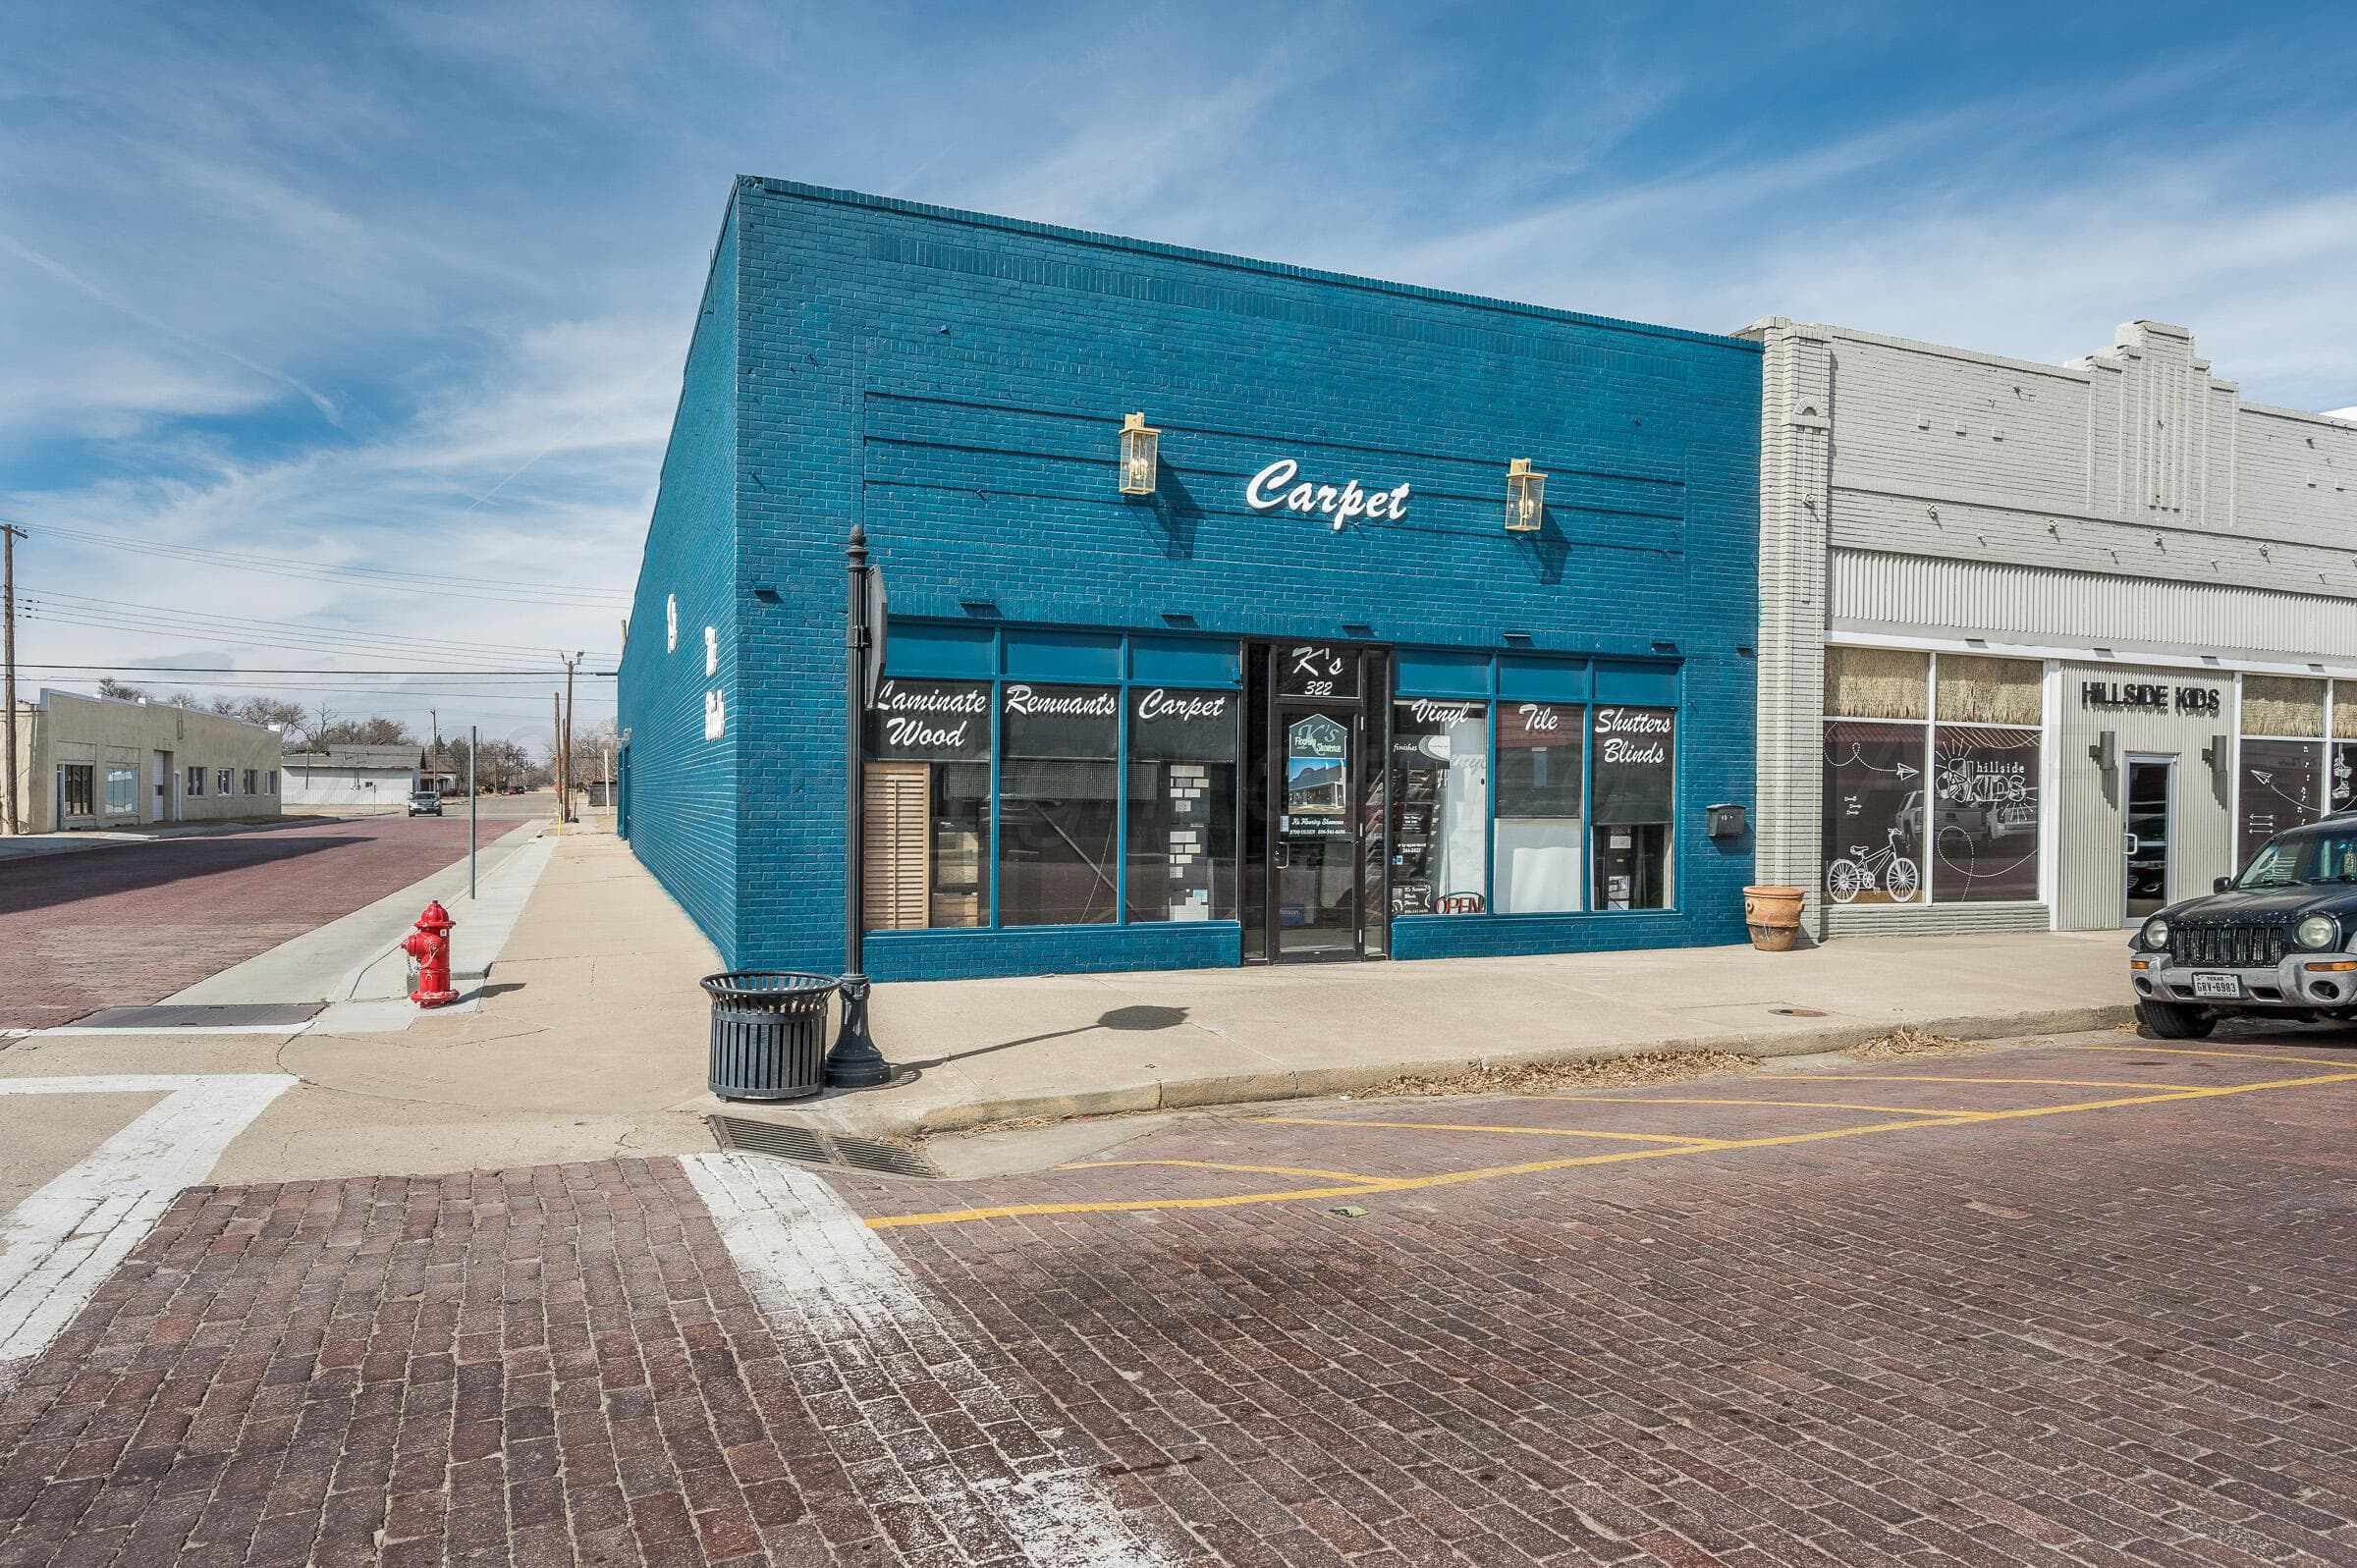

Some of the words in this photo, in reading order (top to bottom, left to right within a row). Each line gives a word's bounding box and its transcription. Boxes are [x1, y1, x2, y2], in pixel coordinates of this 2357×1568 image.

[1246, 459, 1410, 530] Carpet
[1292, 646, 1343, 677] K's
[877, 679, 986, 713] Laminate
[1005, 684, 1117, 715] Remnants
[1304, 680, 1333, 696] 322
[2082, 681, 2168, 706] HILLSIDE
[2175, 686, 2220, 710] KIDS
[1138, 688, 1226, 721] Carpet
[1410, 698, 1469, 729] Vinyl
[1518, 703, 1559, 731] Tile
[886, 717, 967, 747] Wood
[1594, 707, 1672, 733] Shutters
[1393, 743, 1418, 754] finishes
[1603, 737, 1666, 764] Blinds
[1976, 761, 2026, 774] hillside
[1965, 774, 2027, 802] KIDS
[1435, 896, 1485, 915] OPEN
